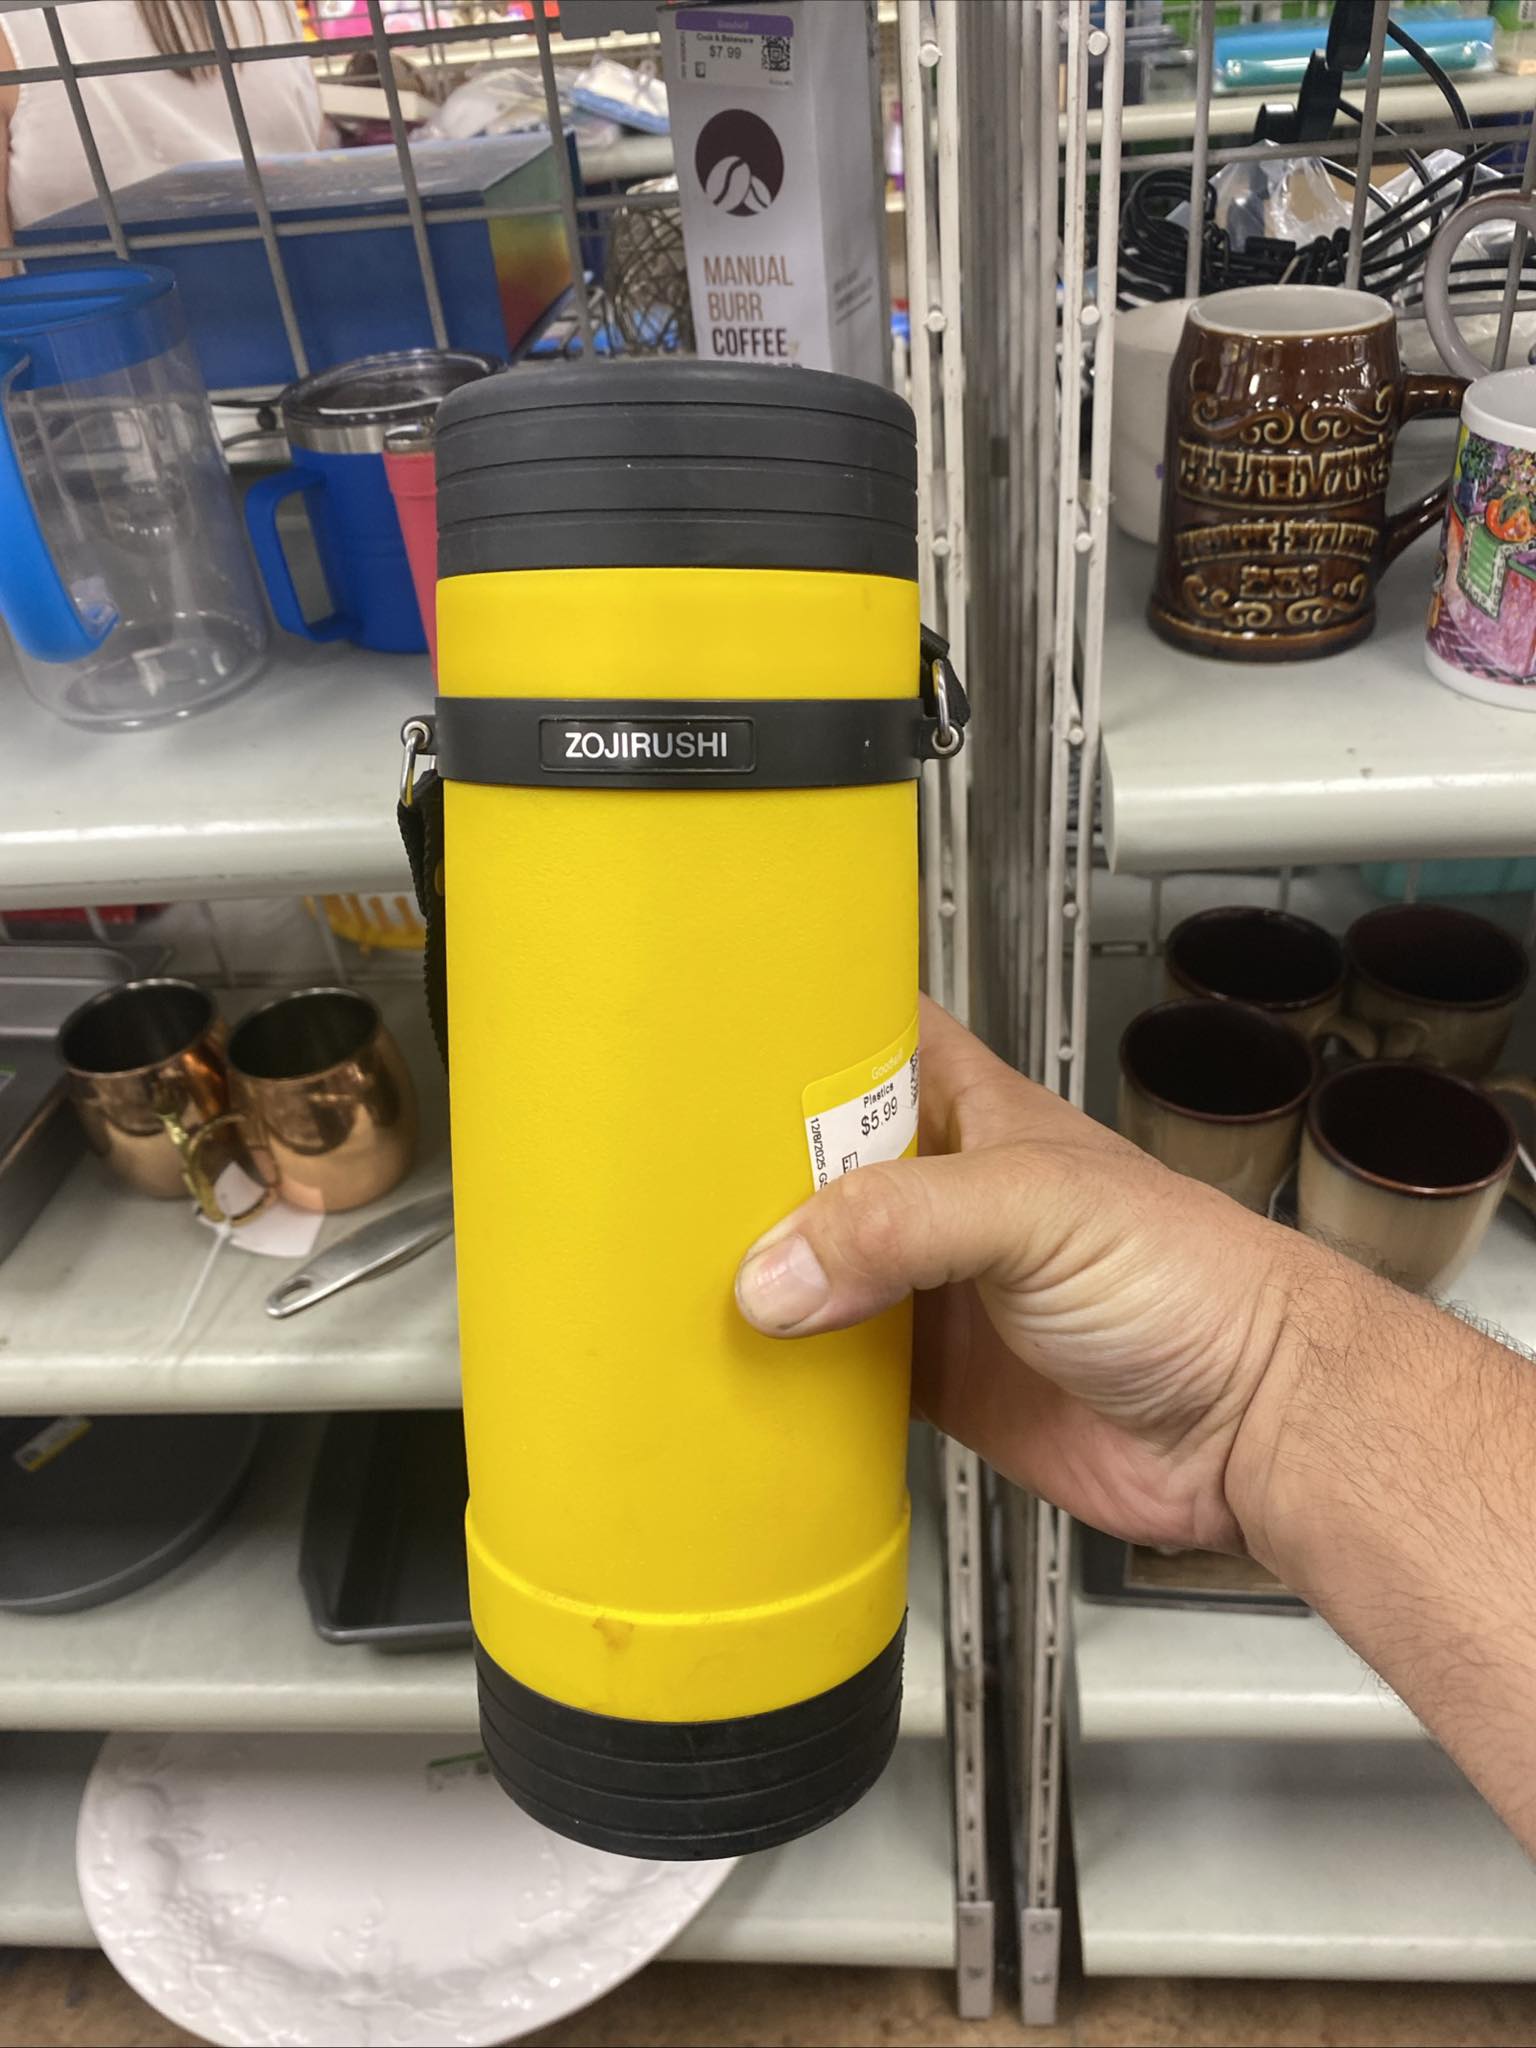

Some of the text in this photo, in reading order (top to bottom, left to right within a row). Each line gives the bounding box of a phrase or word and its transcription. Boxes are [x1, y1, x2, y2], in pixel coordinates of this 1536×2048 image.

[709, 45, 742, 59] $7.99
[703, 255, 794, 287] MANUAL
[707, 292, 764, 322] BURR
[712, 327, 788, 357] COFFEE
[565, 732, 727, 758] ZOJIRUSHI
[863, 1082, 894, 1108] Plastics
[861, 1096, 897, 1137] $5.99
[810, 1118, 826, 1170] 12/8/2025
